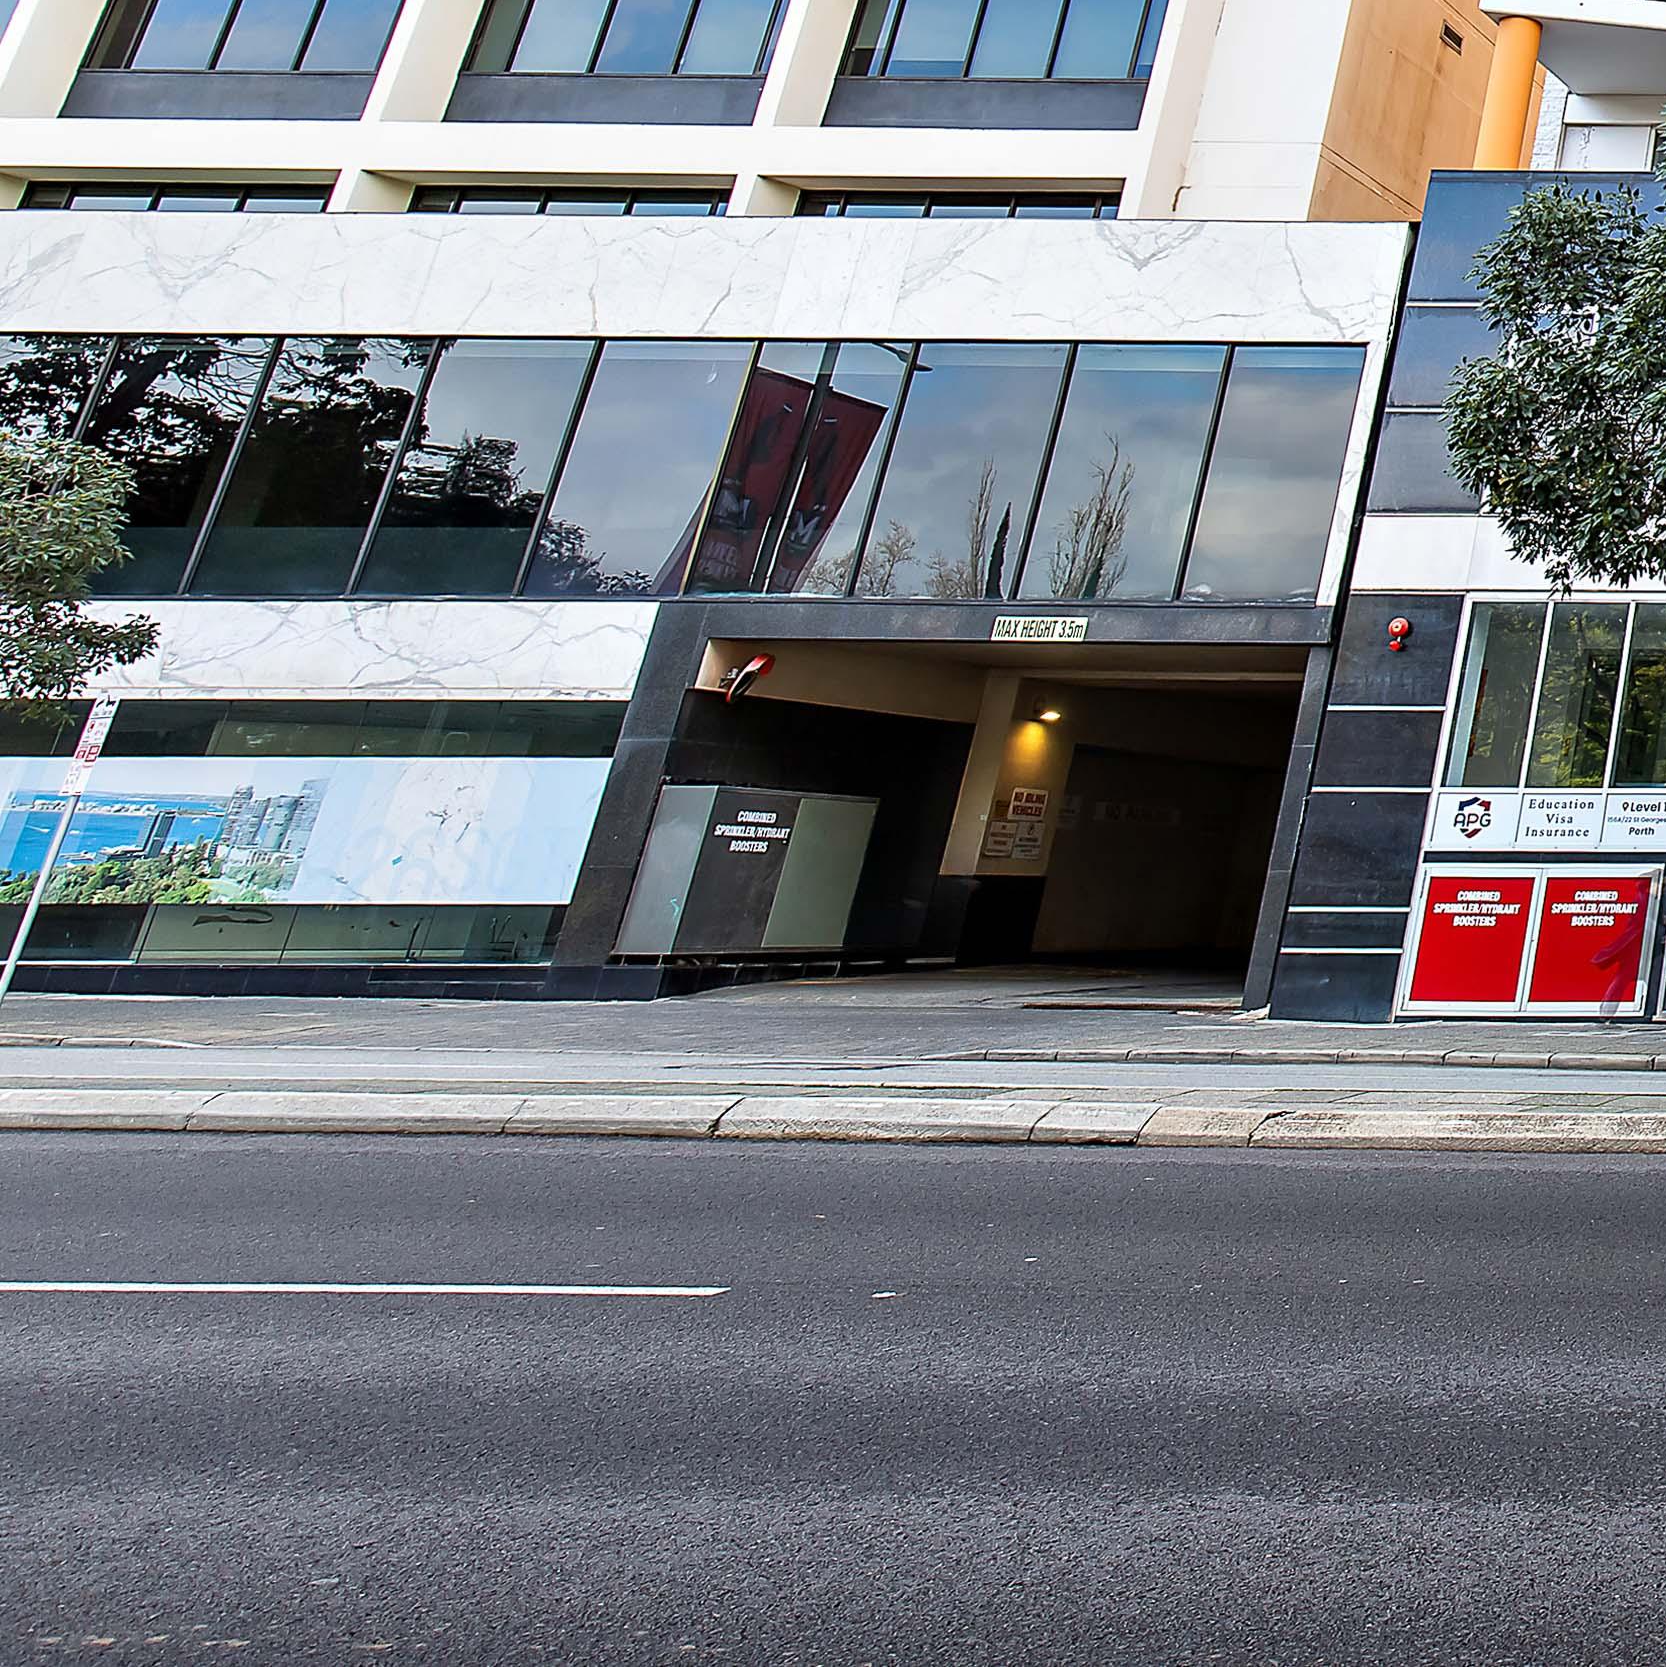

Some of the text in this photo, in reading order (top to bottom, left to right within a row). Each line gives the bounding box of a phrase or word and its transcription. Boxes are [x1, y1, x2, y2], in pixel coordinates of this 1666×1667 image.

[994, 619, 1084, 639] MAX HEIGHT 3.5m
[1528, 798, 1595, 810] Education
[1630, 801, 1662, 813] Level
[737, 810, 777, 823] COMBINED
[1453, 813, 1493, 828] APG
[1546, 813, 1574, 824] Visa
[714, 824, 791, 840] SPRINKLER/HYDRANT
[1525, 827, 1590, 837] Insurance
[1628, 826, 1655, 837] Perth
[729, 840, 769, 852] BOOSTERS
[1456, 891, 1501, 901] COMBINED
[1574, 891, 1619, 901] COMBINED
[1433, 903, 1521, 914] SPRINKLER/HYDRANT
[1551, 903, 1639, 914] SPRINKLER/HYDRANT
[1453, 916, 1496, 926] BOOSTERS
[1571, 916, 1615, 926] BOOSTERS
